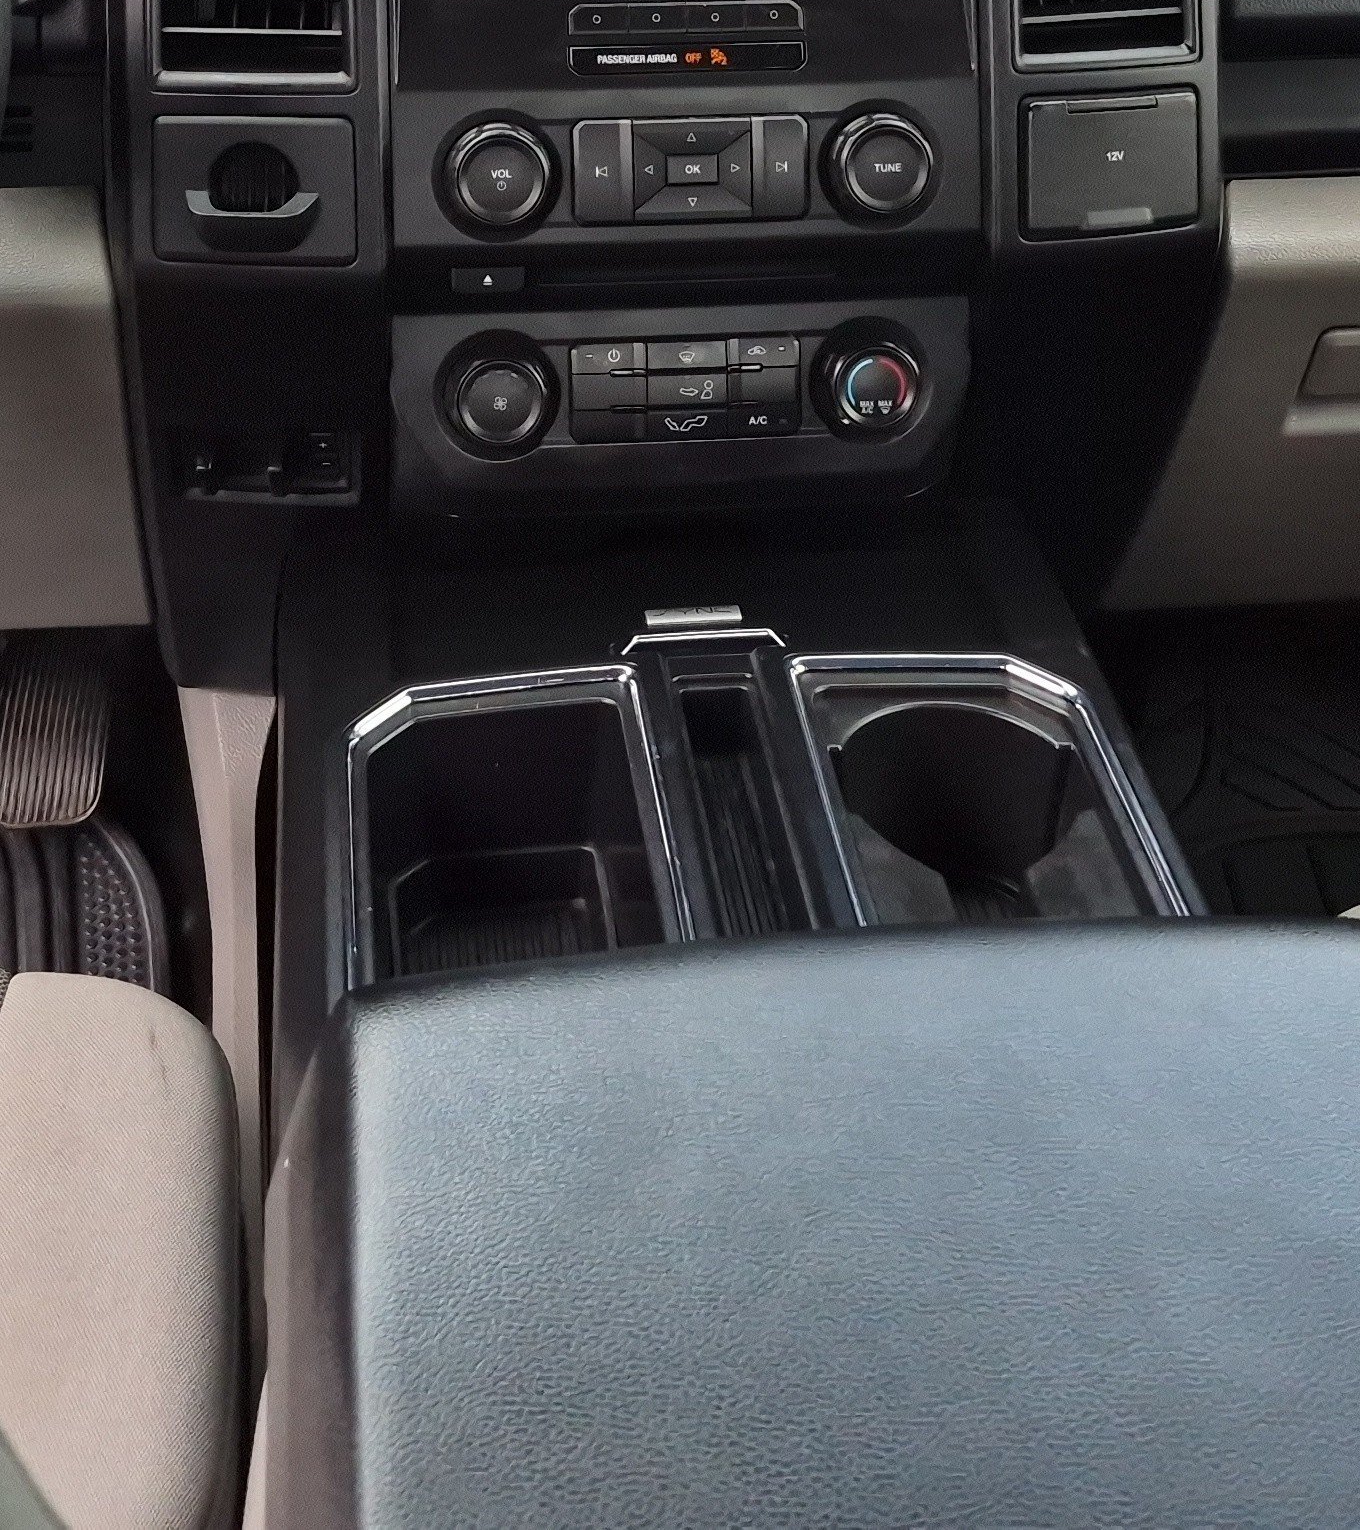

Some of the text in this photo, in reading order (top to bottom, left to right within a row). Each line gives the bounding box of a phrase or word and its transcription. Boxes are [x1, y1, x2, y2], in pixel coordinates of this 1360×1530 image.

[597, 52, 702, 65] PASSENGER AIRBAG OFF
[1106, 150, 1125, 162] 12V
[684, 163, 701, 175] OK
[874, 162, 903, 173] TUNE
[490, 169, 513, 179] VOL
[859, 400, 874, 408] MAX
[877, 400, 893, 408] MAX
[861, 407, 874, 415] A/C
[748, 415, 768, 426] A/C
